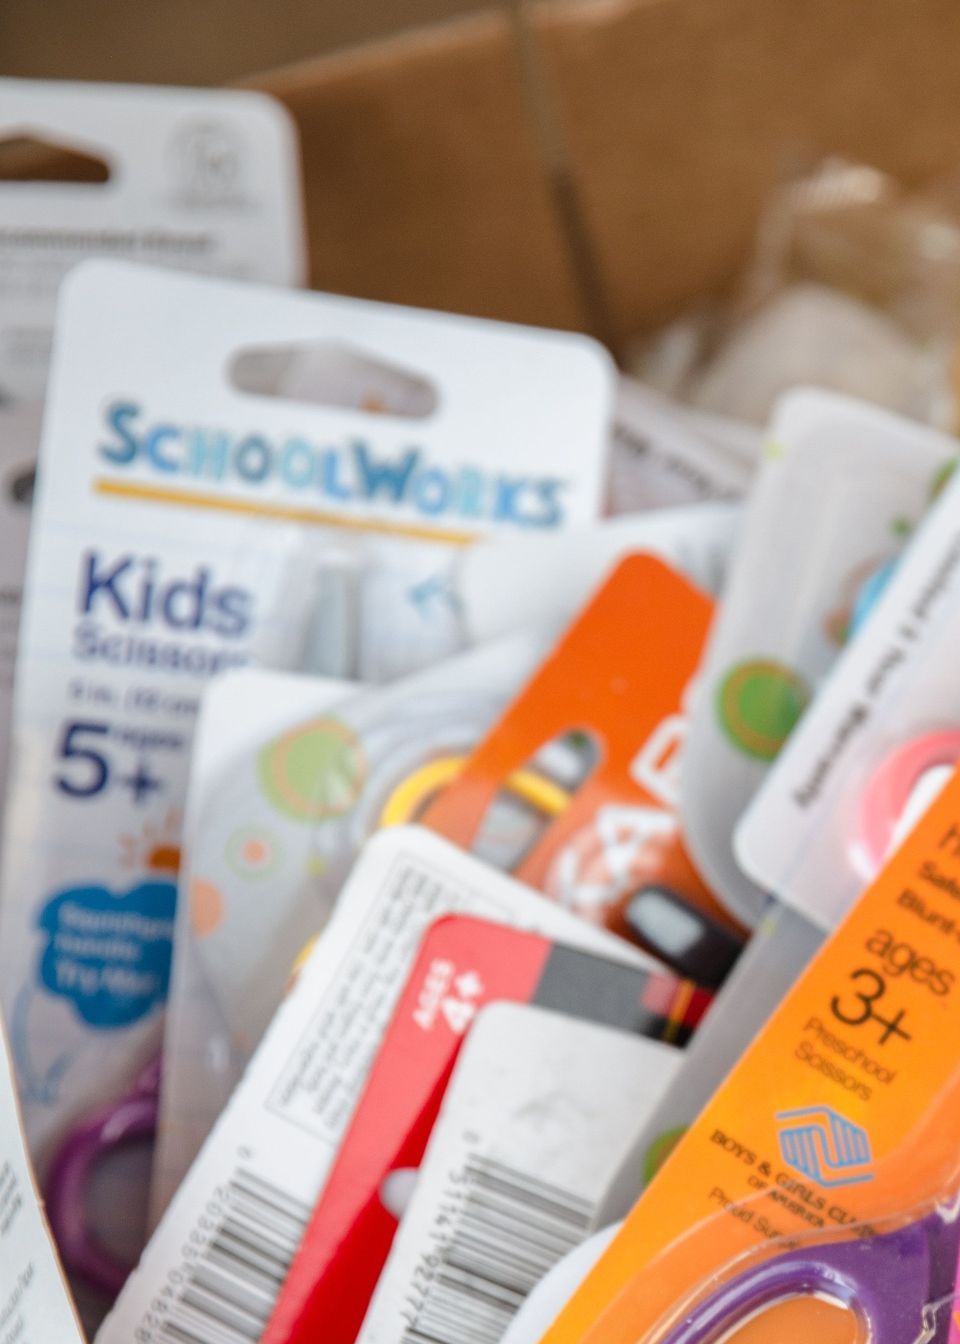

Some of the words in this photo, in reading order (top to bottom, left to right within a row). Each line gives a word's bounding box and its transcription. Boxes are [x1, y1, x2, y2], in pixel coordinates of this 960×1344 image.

[77, 550, 252, 638] Kids
[55, 720, 161, 804] 5+
[864, 928, 957, 998] ages
[829, 967, 912, 1048] 3+
[794, 1041, 874, 1102] Scissors
[802, 1016, 898, 1087] Preschool
[709, 1129, 757, 1167] BOYS
[757, 1160, 774, 1179] &
[776, 1170, 826, 1213] GIRLS
[747, 1174, 770, 1191] OF
